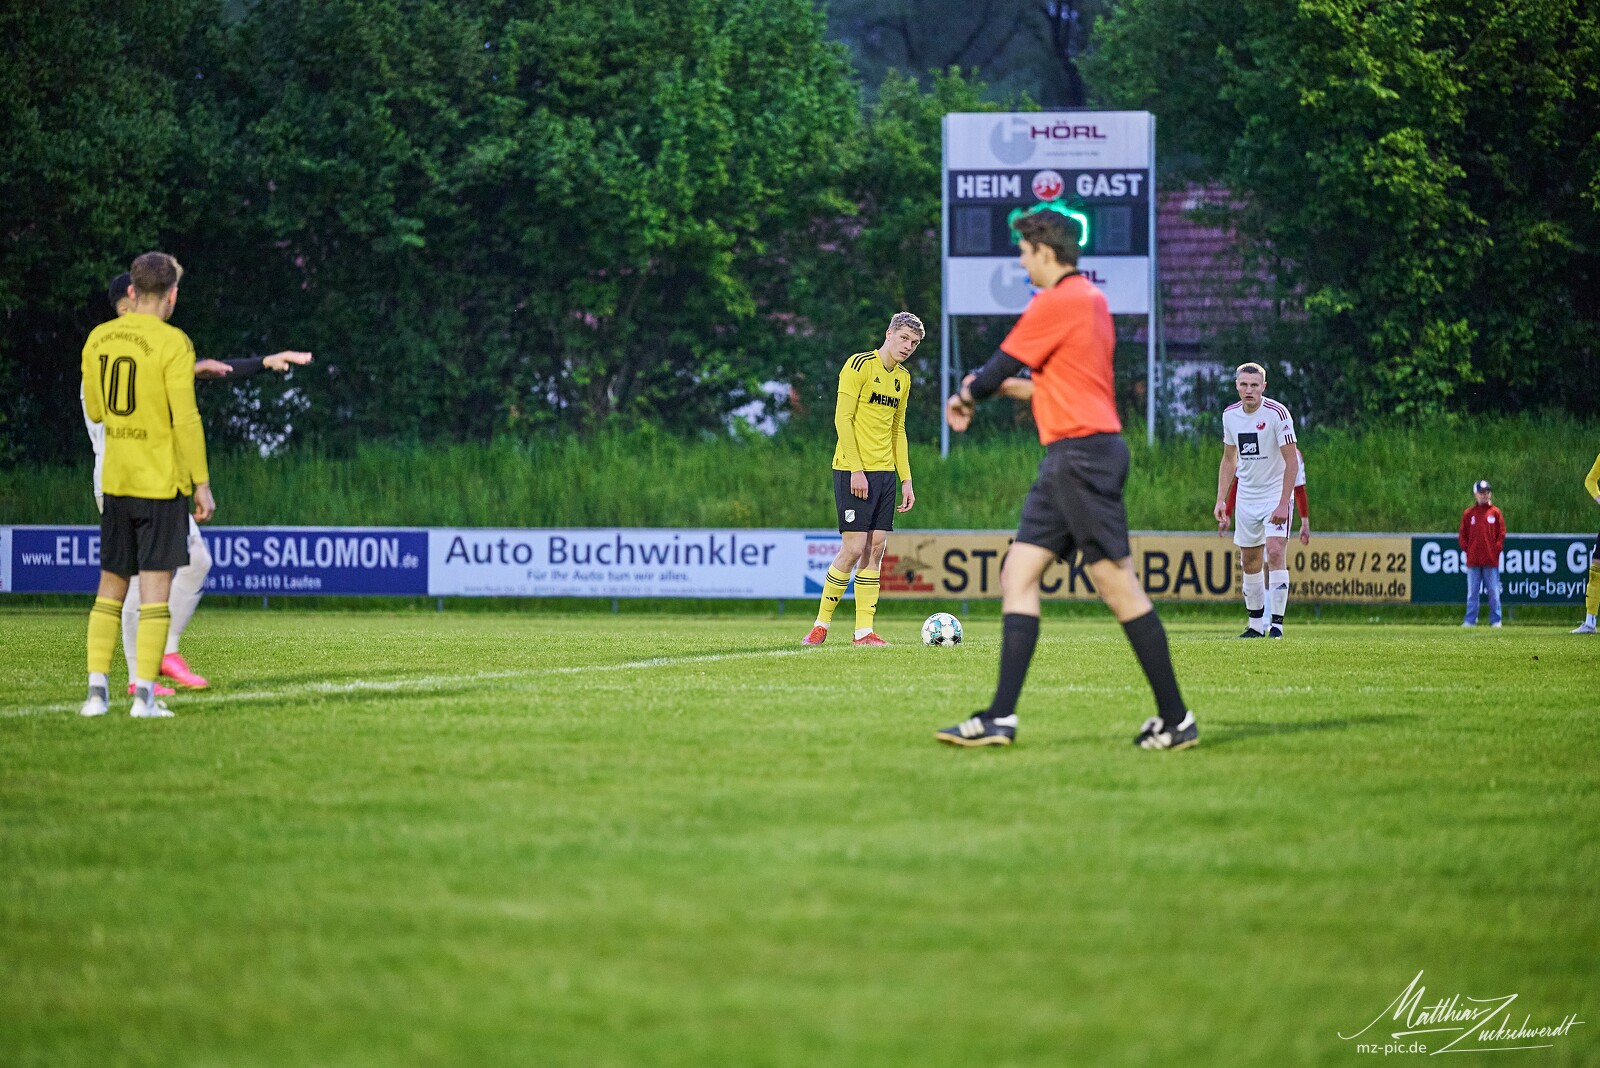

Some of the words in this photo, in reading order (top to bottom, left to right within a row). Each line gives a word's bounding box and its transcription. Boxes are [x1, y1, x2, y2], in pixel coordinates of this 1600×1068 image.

[1031, 120, 1107, 139] HÖRL
[956, 174, 1022, 198] HEIM
[1075, 173, 1144, 197] GAST
[99, 354, 137, 416] 10
[868, 391, 900, 409] MEIND
[21, 536, 419, 568] www.ELEUS-SALOMON.de
[446, 536, 533, 565] Auto
[549, 534, 776, 566] Buchwinkler
[1294, 552, 1305, 572] 0
[1310, 552, 1330, 572] 86
[1336, 552, 1356, 572] 87
[1371, 553, 1381, 572] 2
[1387, 553, 1407, 572] 22
[941, 537, 1233, 594] STCKBAU
[283, 575, 322, 590] Laufen
[1509, 577, 1587, 598] urig-bayri
